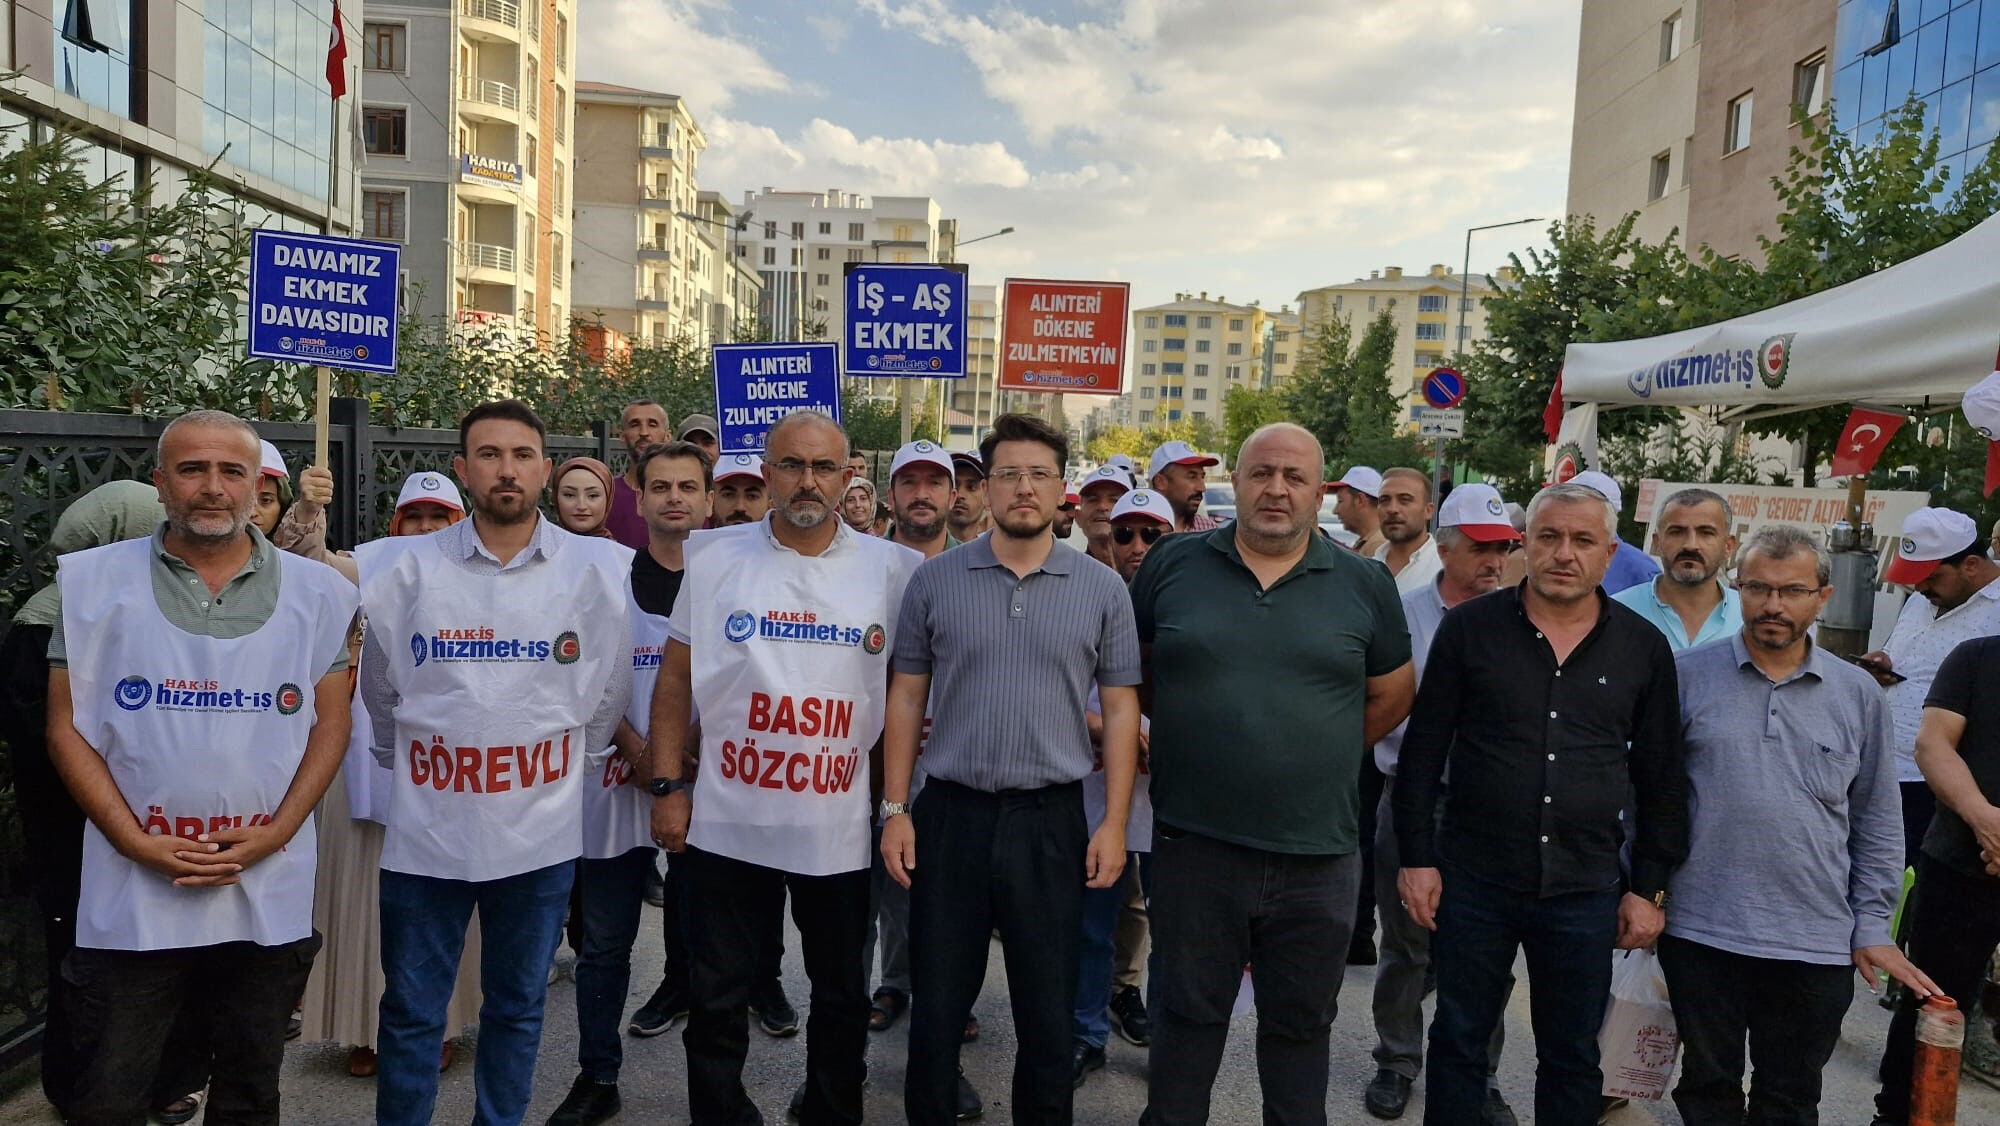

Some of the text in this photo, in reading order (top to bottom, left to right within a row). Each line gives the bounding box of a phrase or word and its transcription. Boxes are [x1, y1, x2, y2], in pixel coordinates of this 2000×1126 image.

[274, 244, 381, 277] DAVAMIZ
[284, 275, 368, 306] EKMEK
[857, 274, 885, 316] İŞ
[912, 283, 951, 317] AŞ
[1030, 291, 1101, 314] ALINTERİ
[261, 303, 388, 338] DAVASIDIR
[1033, 314, 1095, 339] DÖKENE
[855, 322, 953, 351] EKMEK
[741, 351, 812, 376] ALINTERİ
[1008, 342, 1116, 365] ZULMETMEYİN
[747, 377, 808, 400] DÖKENE
[431, 636, 550, 661] hizmet-iş
[156, 684, 272, 712] hizmet-iş
[748, 692, 853, 739] BASIN
[410, 728, 571, 793] GÖREVLİ
[720, 737, 858, 795] SÖZCÜSÜ
